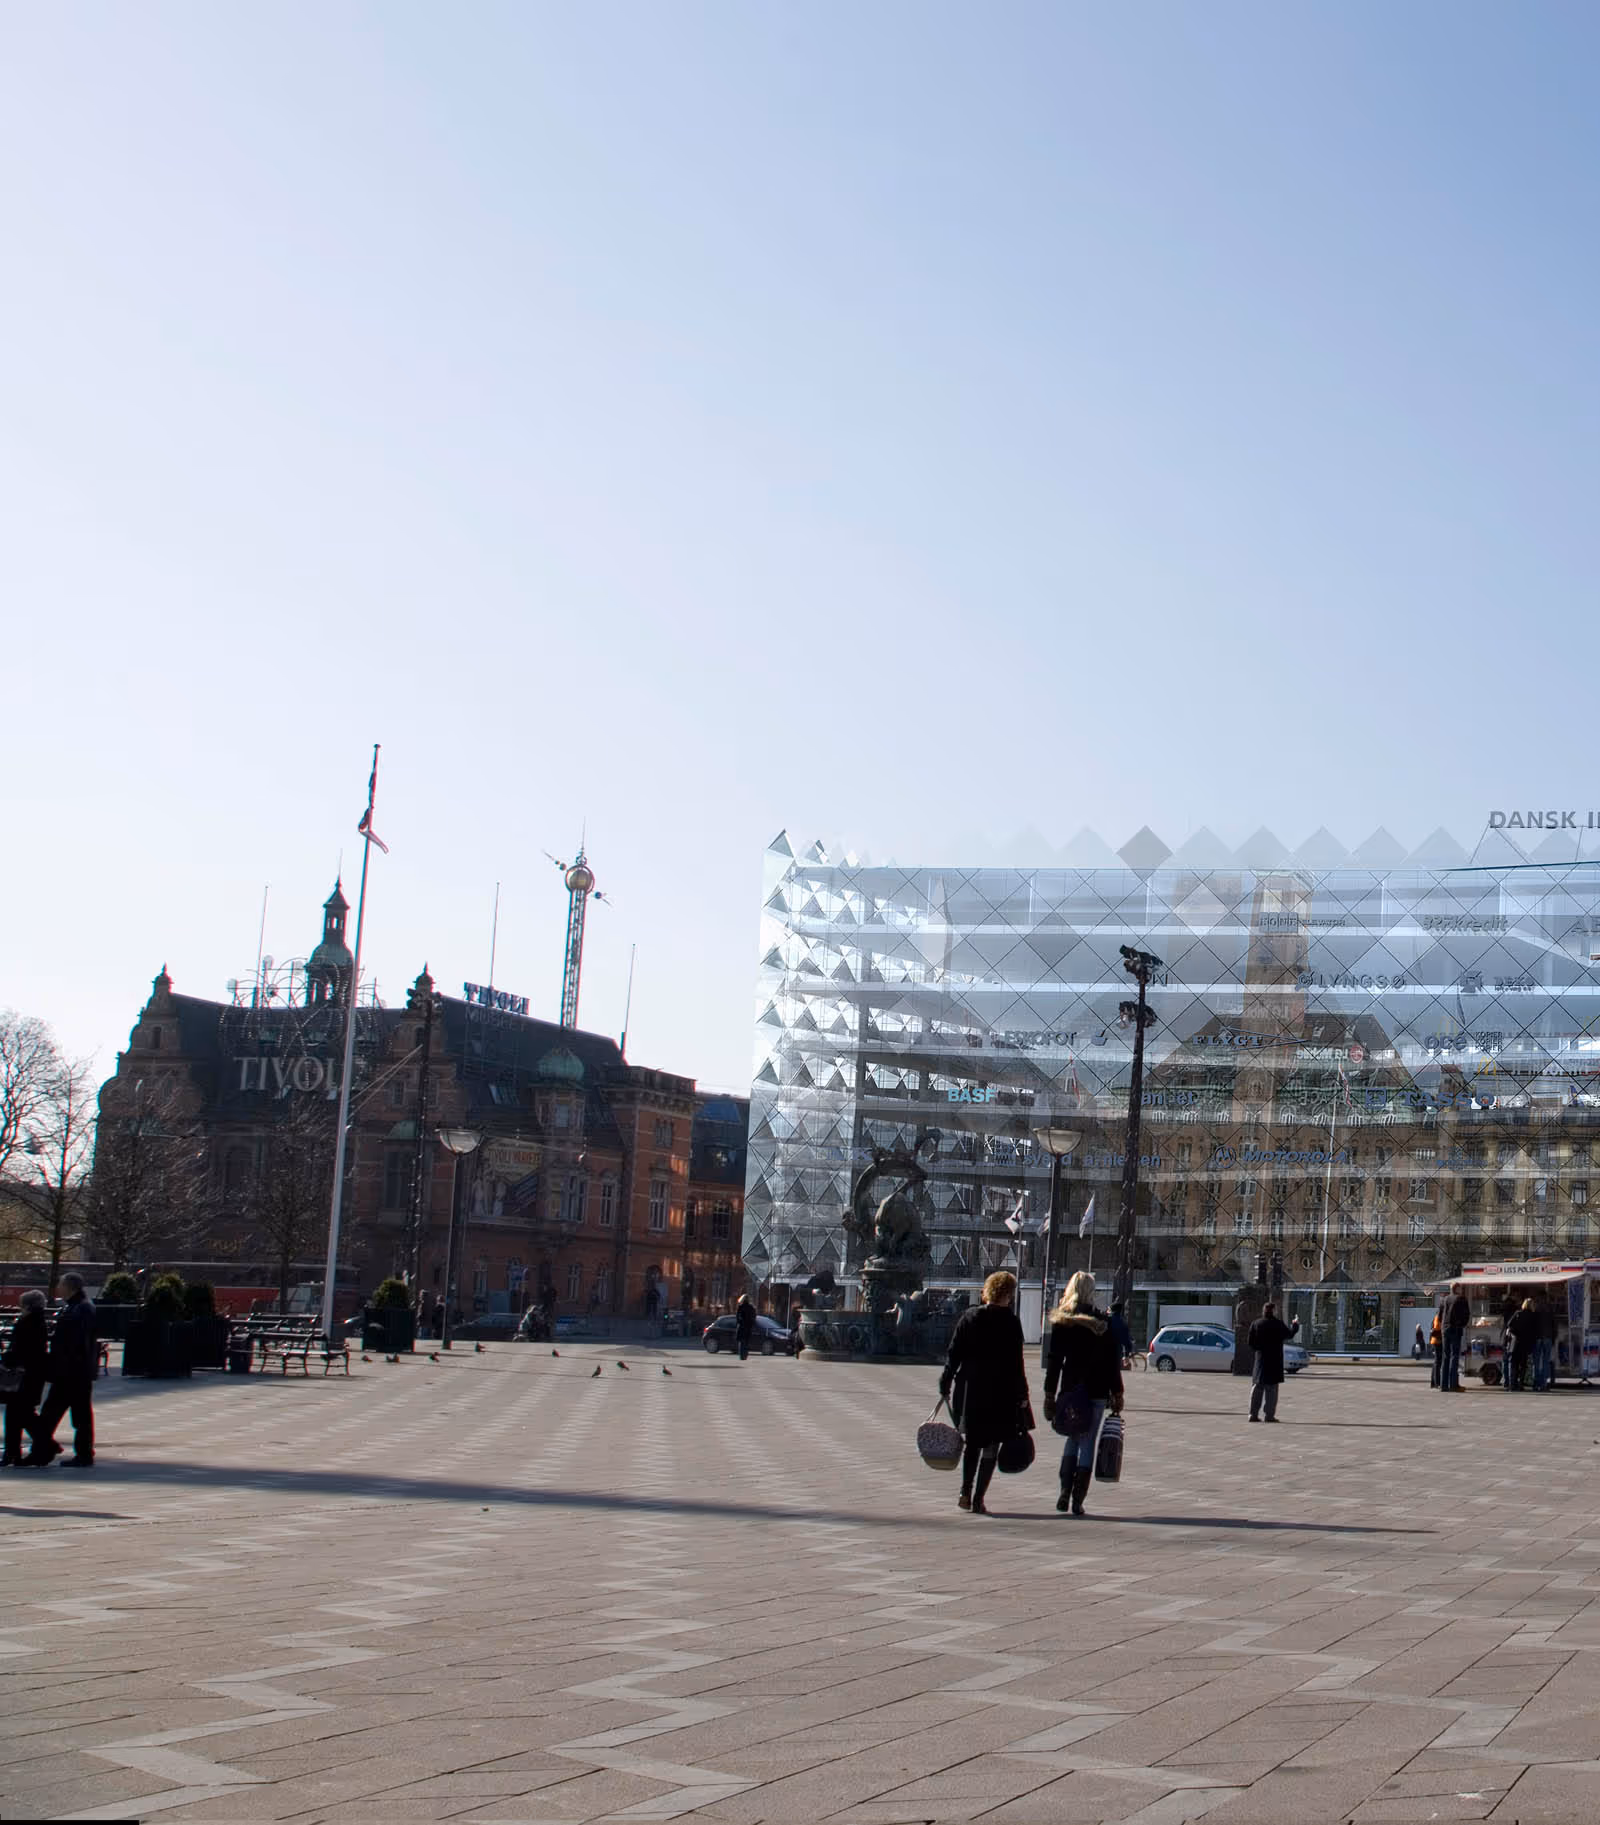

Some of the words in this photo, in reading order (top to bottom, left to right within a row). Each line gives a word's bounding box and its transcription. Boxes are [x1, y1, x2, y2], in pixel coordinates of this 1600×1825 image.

[1489, 811, 1577, 829] DANSK
[464, 981, 530, 1016] TIVOLI
[1192, 1034, 1264, 1047] FLYGT
[947, 1088, 998, 1103] BASF
[1241, 1151, 1347, 1163] MOTOROLA
